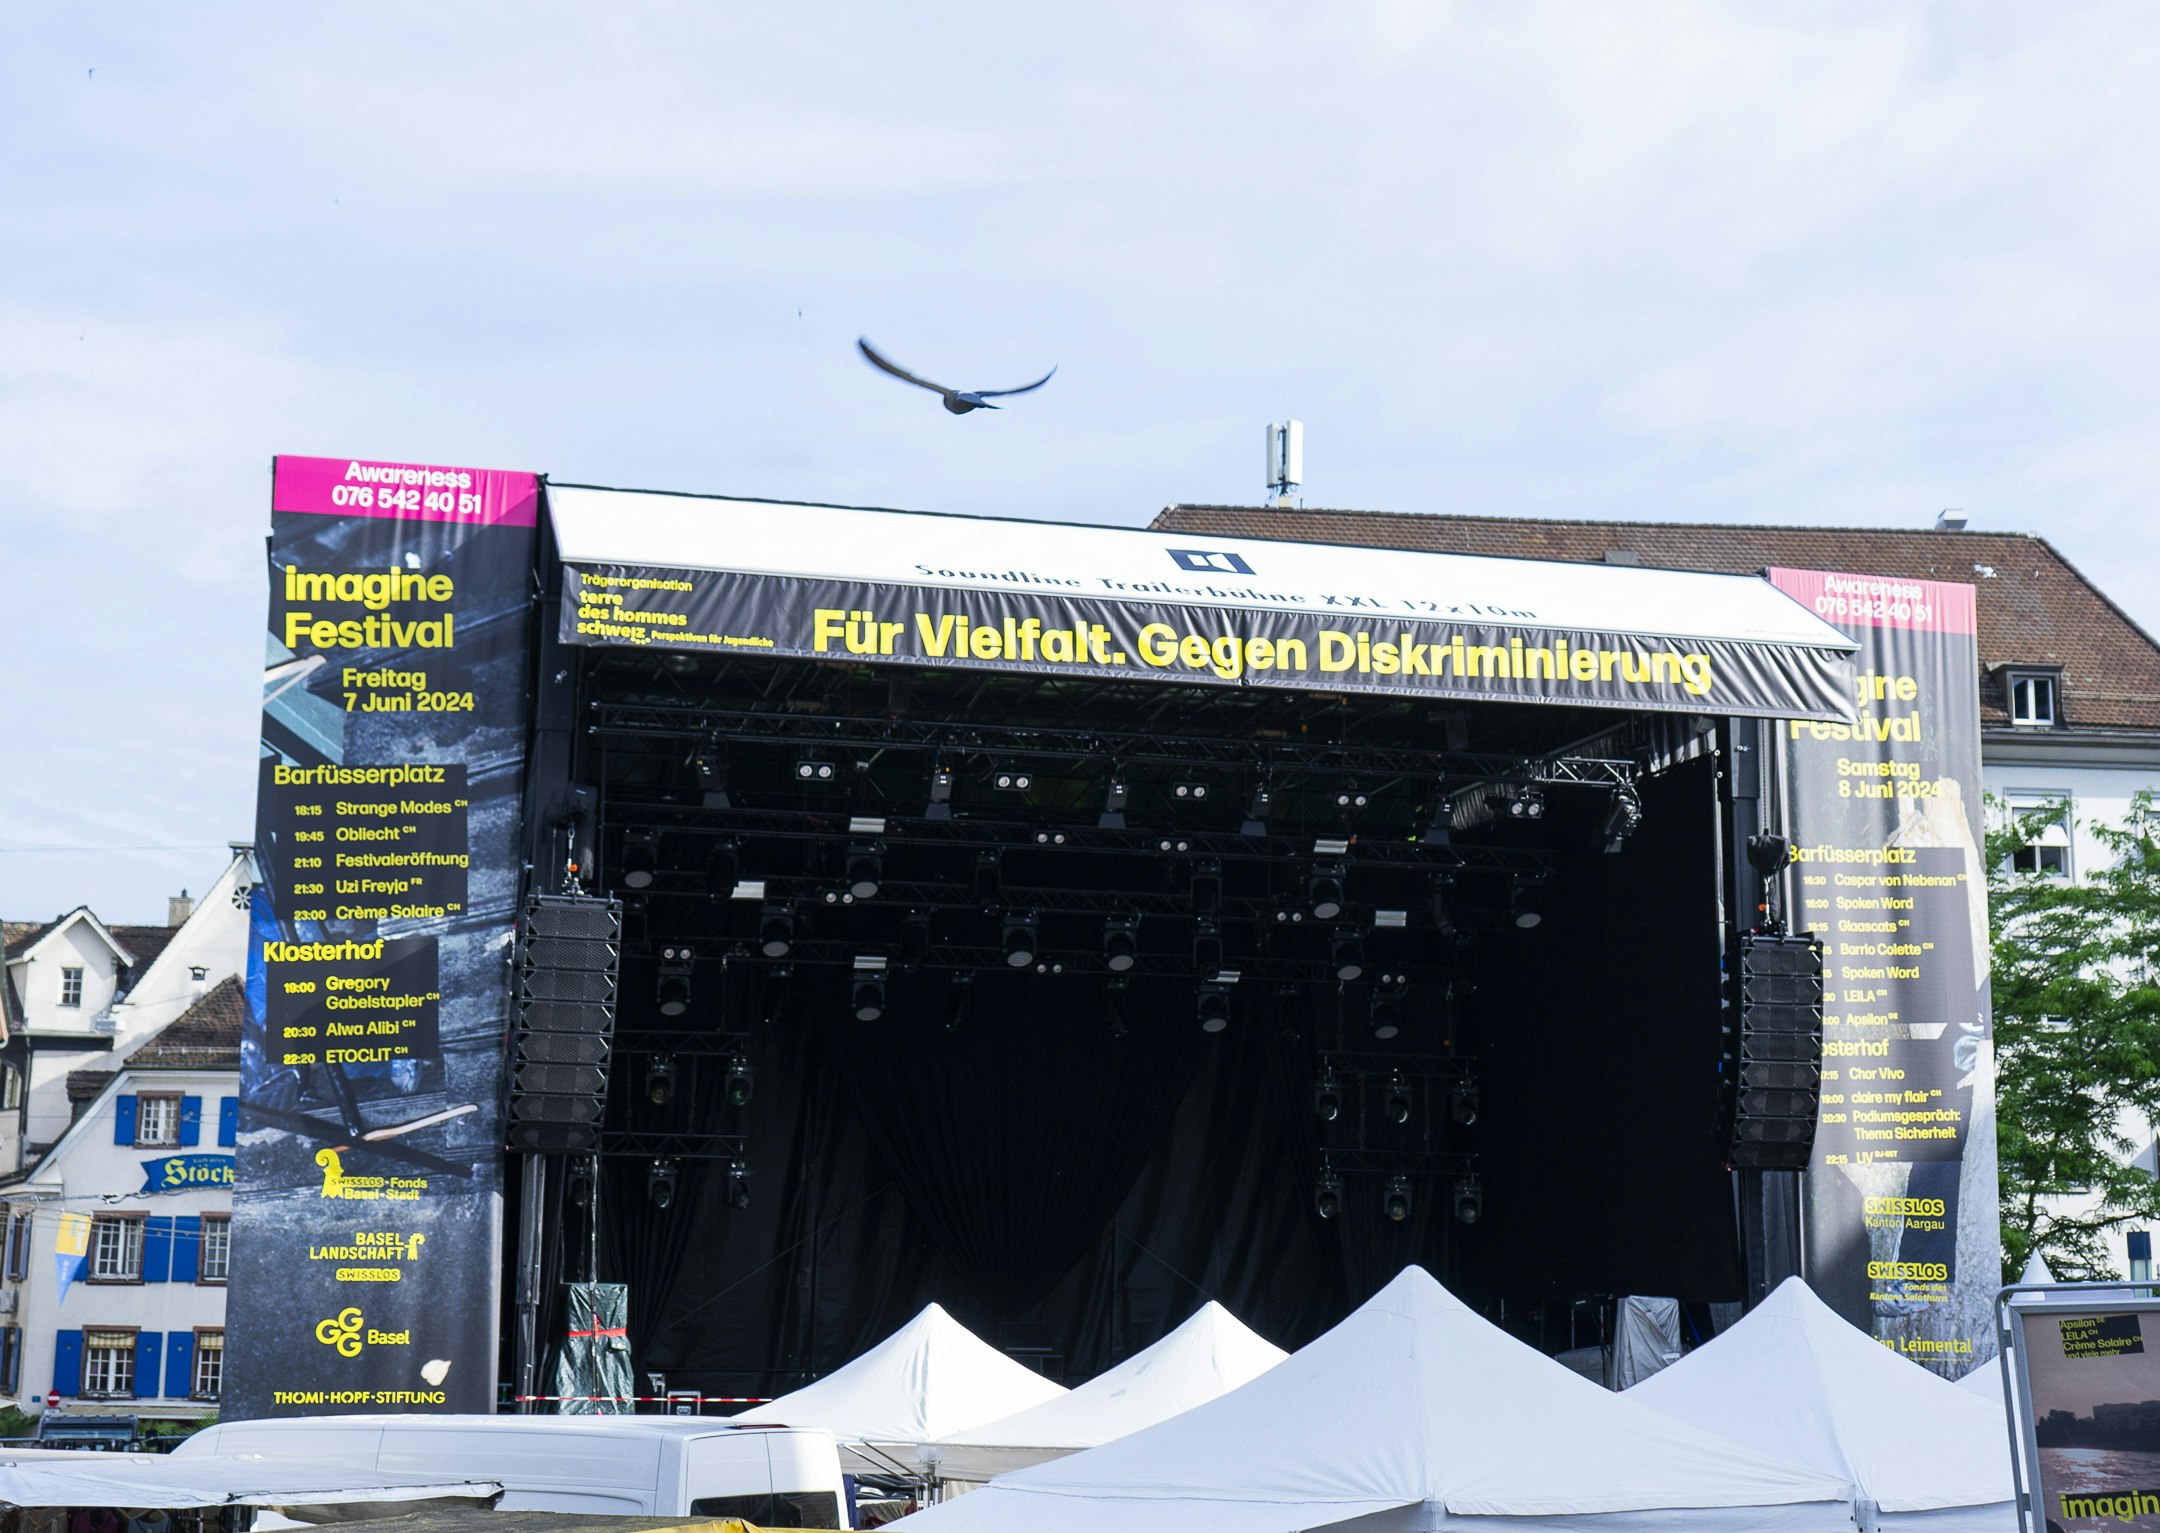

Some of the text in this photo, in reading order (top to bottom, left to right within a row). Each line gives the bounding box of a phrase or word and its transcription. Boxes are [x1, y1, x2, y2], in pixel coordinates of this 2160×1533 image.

[345, 461, 471, 488] Awareness
[331, 485, 481, 514] 076 542 40 51
[285, 565, 453, 610] imagine
[580, 573, 693, 592] Trägerorganisation
[914, 564, 1537, 619] Soundline Trailerbühne XXL 12x10m
[1824, 575, 1923, 600] Awareness
[579, 589, 624, 606] terre
[578, 604, 687, 627] des hommes
[1815, 597, 1933, 623] 076 542 40 51
[285, 612, 453, 649] Festival
[577, 620, 647, 639] schweiz
[651, 630, 774, 648] Perspektiven für Jugendliche
[813, 608, 1712, 695] Für Vielfalt. Gegen Diskriminierung
[342, 667, 426, 691] Freitag
[1856, 668, 1918, 707] gine
[343, 692, 474, 712] 7 Juni 2024
[274, 763, 445, 787] Barfüsserplatz
[1837, 757, 1920, 780] Samstag
[1839, 780, 1943, 799] 8 Juni 2024
[294, 799, 468, 818] 18:15 Strange Modes CH
[294, 825, 416, 843] 19:45 Obliecht CH
[294, 852, 469, 869] 21:10 Festivaleröffnung
[1789, 845, 1917, 867] Barfüsserplatz
[294, 877, 423, 896] 21:30 Uzi Freyja FR
[1834, 873, 1876, 889] Caspar
[1879, 876, 1901, 887] von
[1903, 874, 1957, 887] Nebenan
[294, 903, 461, 921] 23:00 Crème Solaire CH
[1836, 896, 1879, 911] Spoken
[1880, 897, 1914, 909] Word
[1838, 920, 1898, 933] Glaascats
[1898, 919, 1910, 927] CH
[263, 939, 384, 963] Klosterhof
[1840, 943, 1876, 956] Barrio
[1877, 943, 1921, 956] Colette
[1922, 942, 1934, 950] CH
[1842, 966, 1885, 981] Spoken
[1886, 966, 1920, 979] Word
[283, 975, 390, 994] 19:00 Gregory
[325, 992, 440, 1012] Gabelstapler CH
[1844, 989, 1876, 1003] LEILA
[1877, 989, 1888, 997] CH
[283, 1019, 416, 1039] 20:30 Alwa Alibi CH
[1846, 1013, 1889, 1027] Apsilon
[283, 1046, 408, 1065] 22:20 ETOCLIT CH
[1821, 1038, 1889, 1057] osterhof
[1849, 1066, 1877, 1081] Chor
[1879, 1066, 1905, 1081] Vivo
[1851, 1091, 1883, 1104] claire
[1884, 1093, 1902, 1106] my
[1904, 1090, 1929, 1103] flair
[1930, 1088, 1942, 1097] CH
[1822, 1109, 1961, 1125] 20:30 Podiumsgespräch:
[1854, 1126, 1957, 1140] Thema Sicherheit
[1825, 1154, 1849, 1165] 22:15
[1865, 1197, 1946, 1216] SWISSLOS
[1865, 1217, 1945, 1232] Kanton Aargau
[355, 1232, 404, 1246] BASEL
[309, 1246, 405, 1260] LANDSCHAFT
[336, 1268, 400, 1281] SWISSLOS
[1867, 1262, 1948, 1281] SWISSLOS
[1904, 1283, 1947, 1291] Fonds des
[2060, 1318, 2096, 1331] Apsilon
[367, 1329, 410, 1345] Basel
[1900, 1336, 1972, 1354] Leimental
[2061, 1331, 2088, 1341] LEILA
[2063, 1340, 2096, 1351] Crème
[2097, 1337, 2132, 1348] Solaire
[2065, 1349, 2121, 1360] und viele mehr
[2060, 1489, 2160, 1522] imagin
